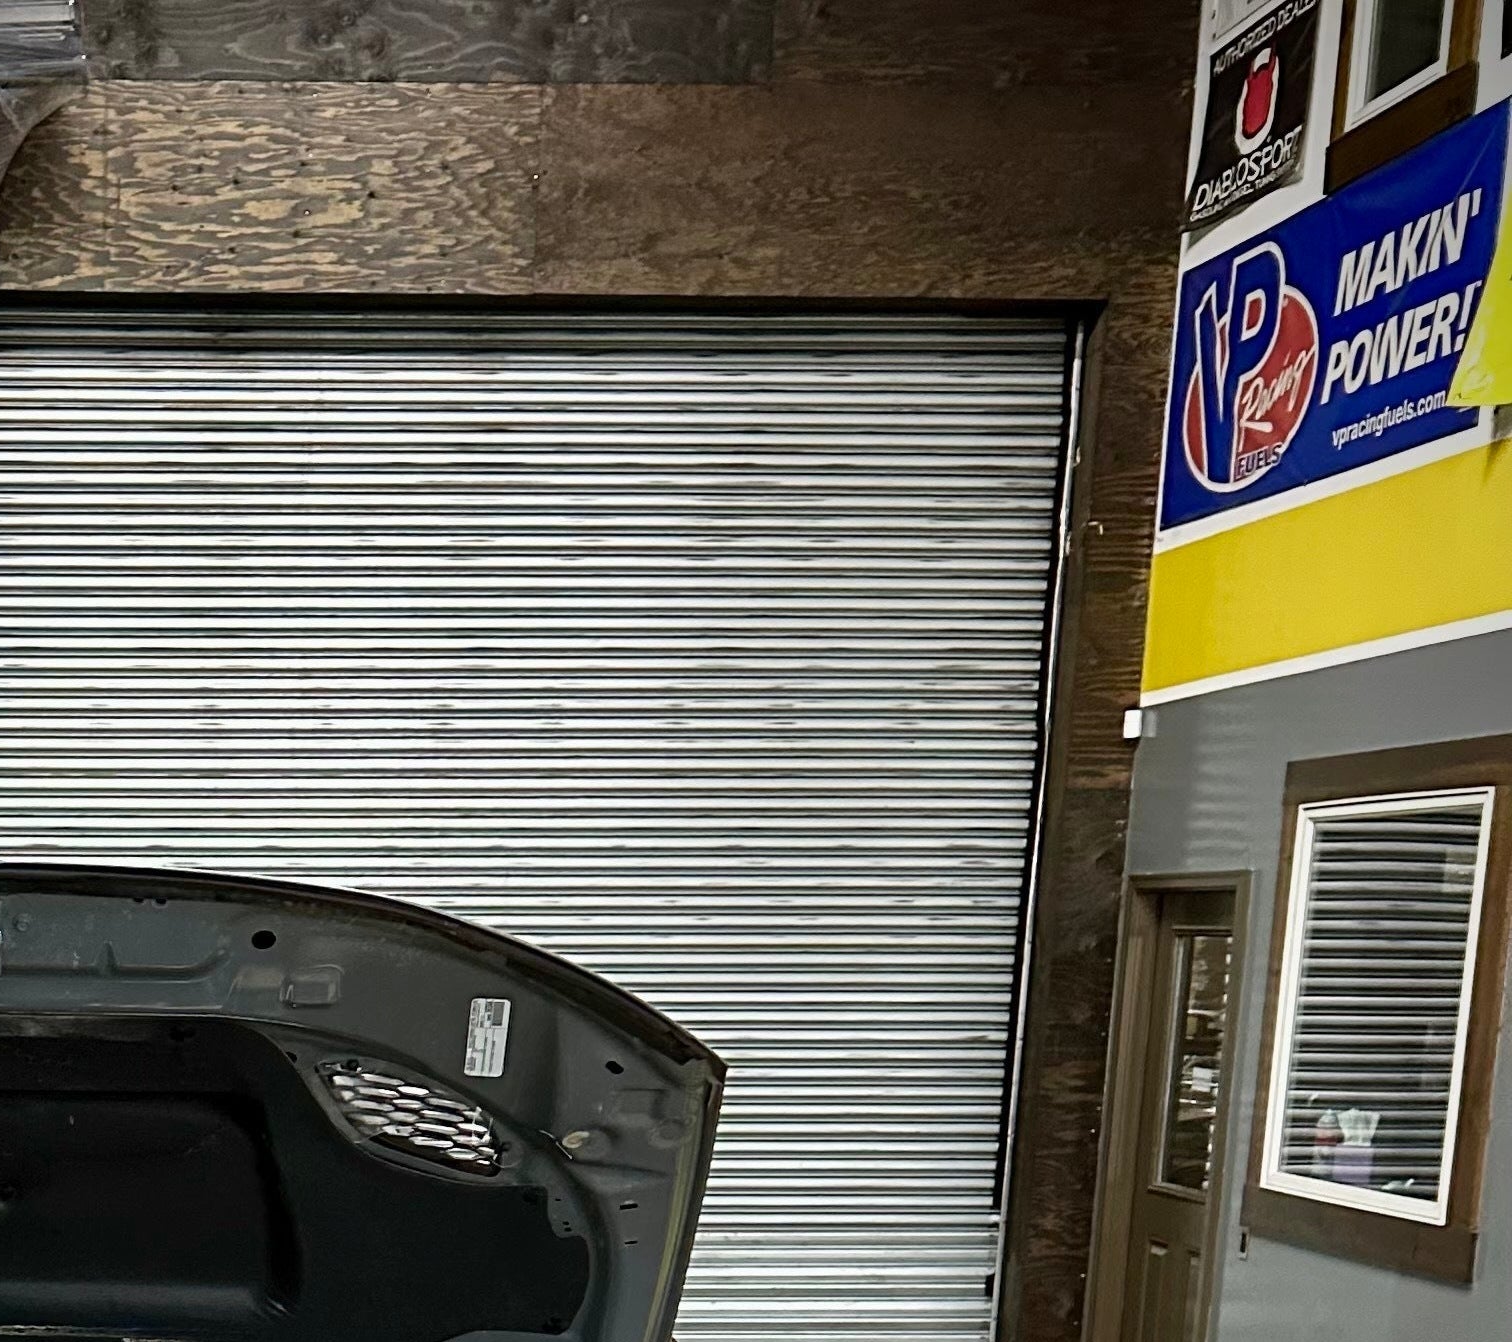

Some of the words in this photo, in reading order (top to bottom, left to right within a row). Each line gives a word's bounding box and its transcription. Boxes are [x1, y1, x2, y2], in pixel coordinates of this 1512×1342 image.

[1193, 124, 1302, 212] DIABLOSPORT
[1334, 188, 1482, 316] MAKIN'
[1194, 241, 1286, 484] VP
[1321, 280, 1482, 405] POWER!
[1240, 346, 1318, 453] Racing
[1332, 390, 1447, 450] vpracingfuels.com
[1235, 445, 1283, 481] FUELS
